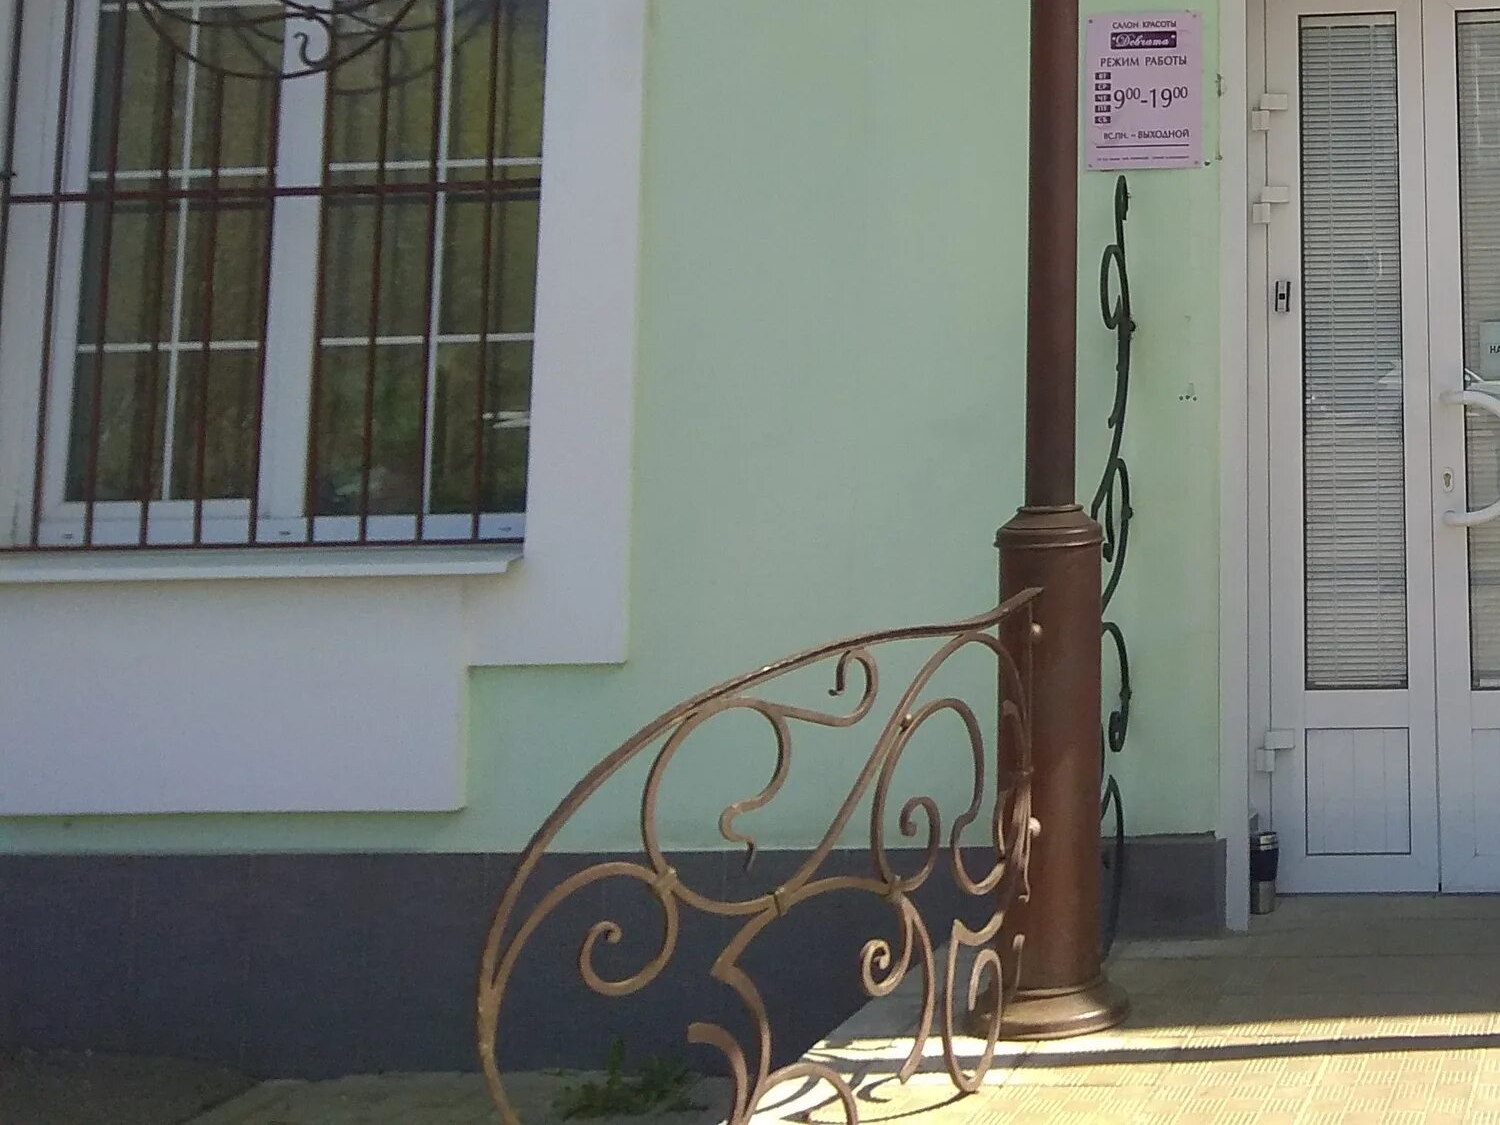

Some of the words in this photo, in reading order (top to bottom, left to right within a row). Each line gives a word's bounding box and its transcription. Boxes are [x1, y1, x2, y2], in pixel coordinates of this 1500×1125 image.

[1112, 21, 1139, 29] САЛОН
[1142, 20, 1177, 29] КРАСОТЫ
[1100, 57, 1139, 67] РЕЖИМ
[1145, 55, 1187, 66] РАБОТЫ
[1138, 129, 1190, 139] ВЫХОДНОЙ
